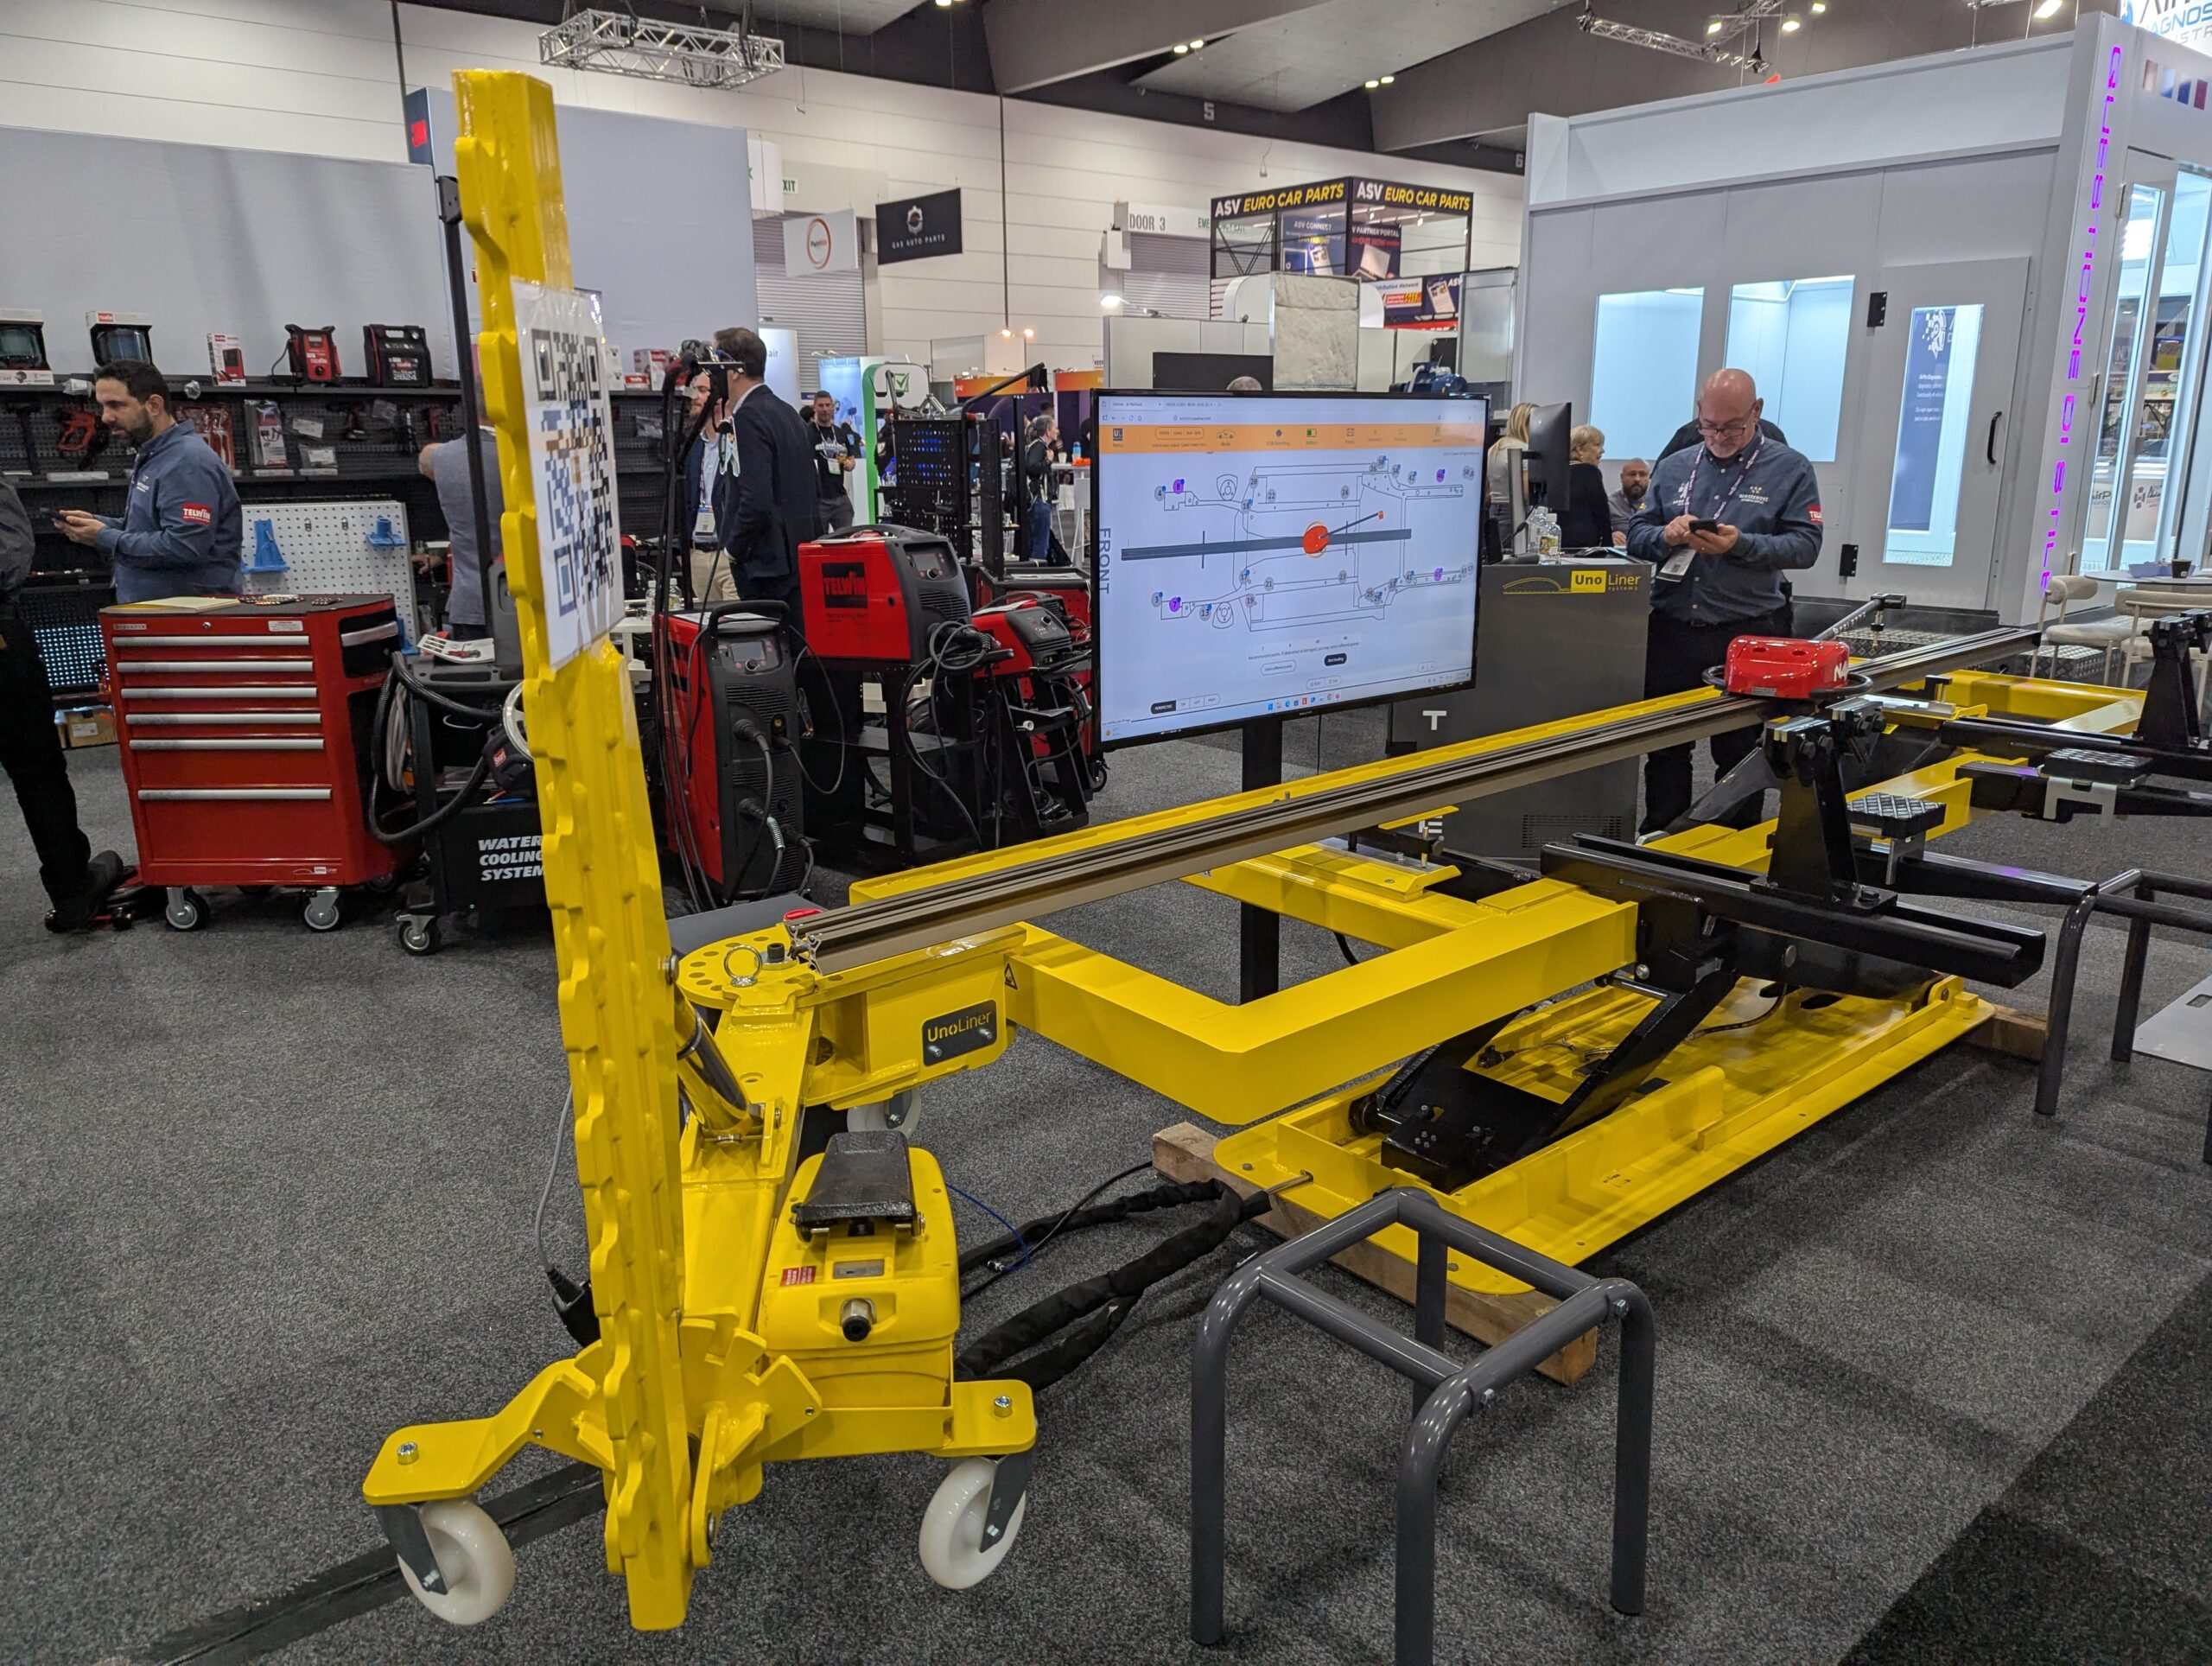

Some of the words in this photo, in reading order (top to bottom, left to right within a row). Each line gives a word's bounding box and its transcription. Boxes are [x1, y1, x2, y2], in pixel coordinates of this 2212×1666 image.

[1204, 102, 1215, 121] 5
[1516, 153, 1524, 169] 6
[782, 179, 796, 192] XIT
[1215, 198, 1242, 218] ASV
[1243, 194, 1275, 213] EURO
[1277, 188, 1303, 208] CAR
[1305, 182, 1344, 204] PARTS
[1357, 181, 1383, 201] ASV
[1384, 188, 1414, 206] EURO
[1415, 191, 1438, 207] CAR
[1439, 194, 1471, 212] PARTS
[1129, 213, 1155, 232] DOOR
[1159, 216, 1166, 232] 3
[1294, 220, 1306, 229] ASV
[1357, 226, 1380, 235] PARTNER
[1380, 228, 1400, 237] PORTAL
[906, 238, 923, 247] AUTO
[1099, 527, 1111, 595] FRONT
[1574, 575, 1603, 586] Uno
[1608, 574, 1641, 586] Liner
[1201, 608, 1210, 617] 13
[478, 835, 543, 851] WATER
[480, 865, 545, 881] SYSTEM
[927, 1011, 993, 1042] UnoLiner
